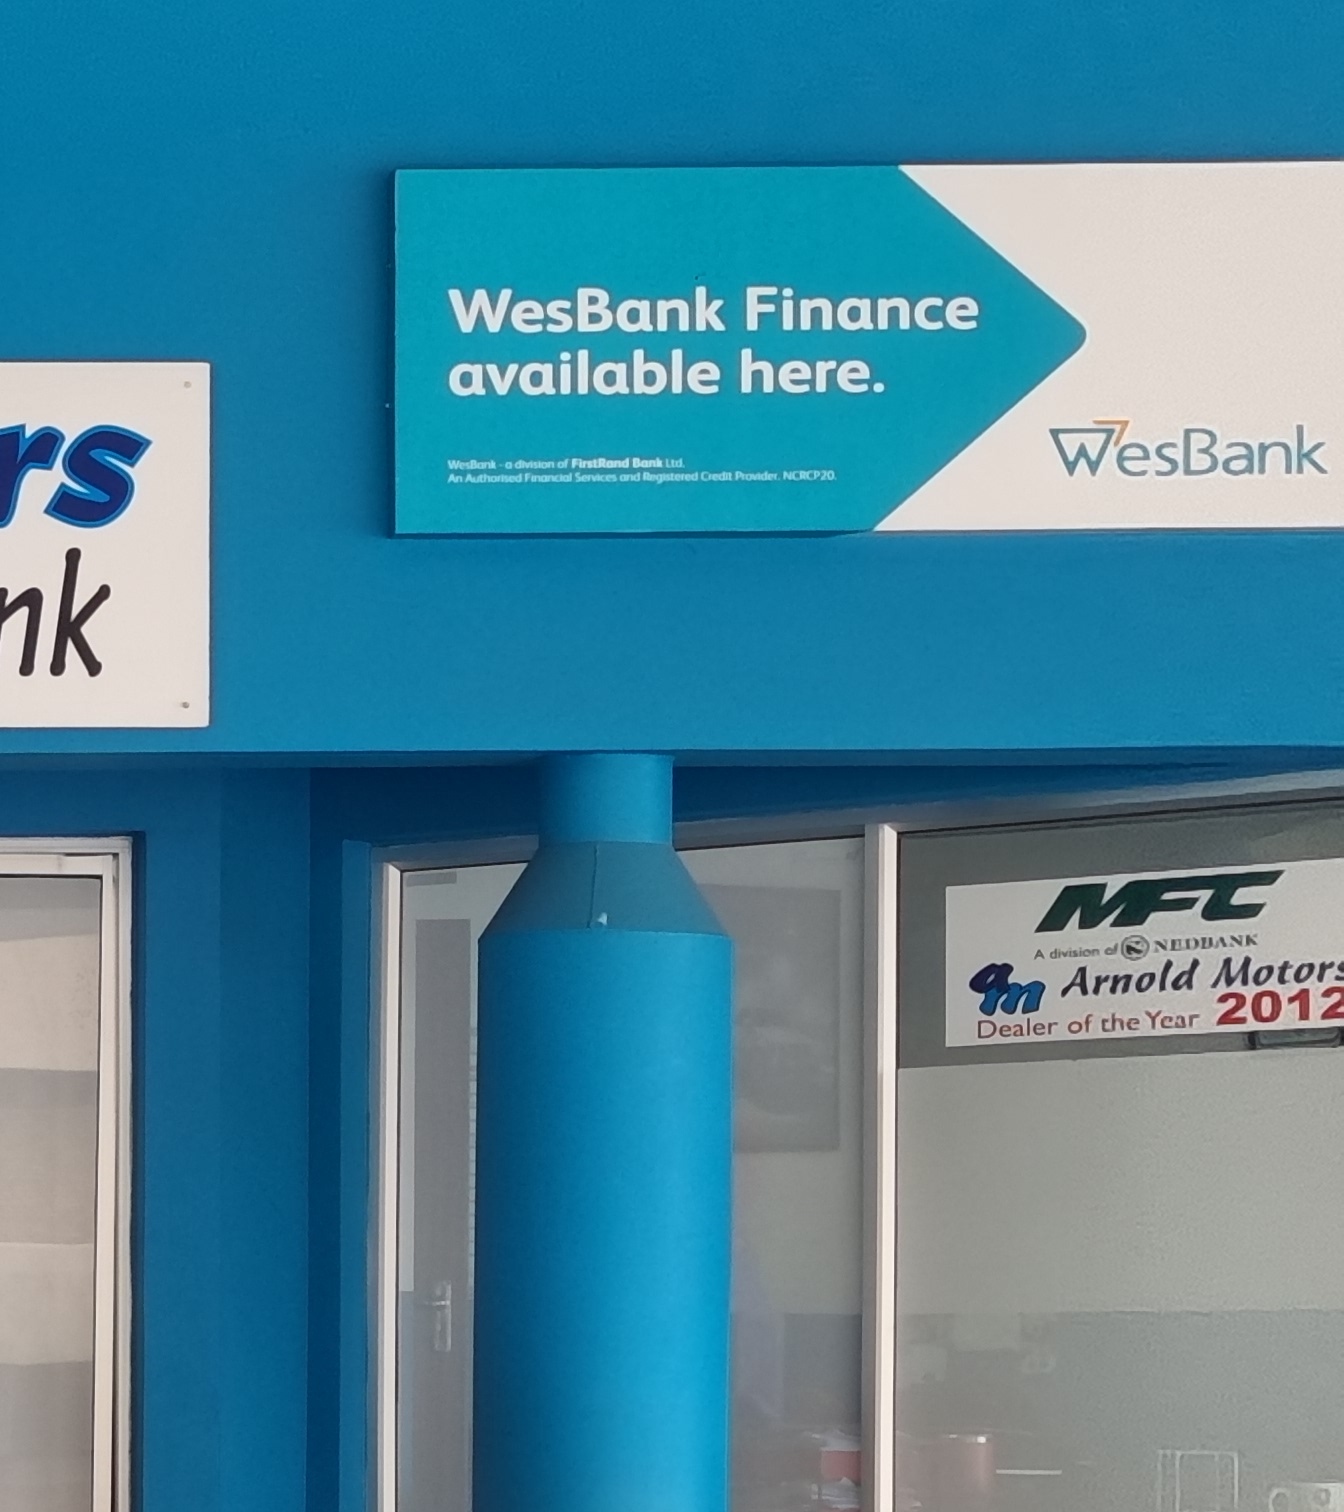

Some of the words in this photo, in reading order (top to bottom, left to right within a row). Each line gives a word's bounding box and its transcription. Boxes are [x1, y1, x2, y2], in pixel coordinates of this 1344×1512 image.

[447, 285, 727, 334] WesBank
[745, 285, 980, 332] Finance
[448, 348, 721, 397] available
[740, 347, 886, 394] here.
[447, 459, 496, 470] WesBank
[505, 461, 512, 470] a
[514, 458, 555, 469] division
[557, 458, 569, 469] of
[571, 457, 630, 469] FirstRand
[632, 457, 663, 468] Bank
[665, 457, 685, 469] Ltd.
[1048, 424, 1329, 477] WesBank
[447, 473, 462, 483] An
[464, 472, 523, 483] Authorised
[524, 472, 572, 483] Financial
[574, 472, 617, 482] Services
[619, 471, 641, 482] and
[643, 471, 699, 485] Registered
[700, 470, 733, 482] Credit
[735, 470, 781, 482] Provider.
[1033, 869, 1285, 933] MFC
[1033, 949, 1045, 960] A
[1049, 947, 1100, 959] division
[1104, 943, 1118, 956] of
[1153, 933, 1259, 954] NEDBANK
[1060, 958, 1201, 998] Arnold
[1210, 955, 1344, 989] Motors
[977, 1017, 1059, 1040] Dealer
[1067, 1013, 1093, 1035] of
[1101, 1012, 1141, 1033] the
[1145, 1010, 1200, 1031] Year
[1216, 986, 1344, 1026] 2012
